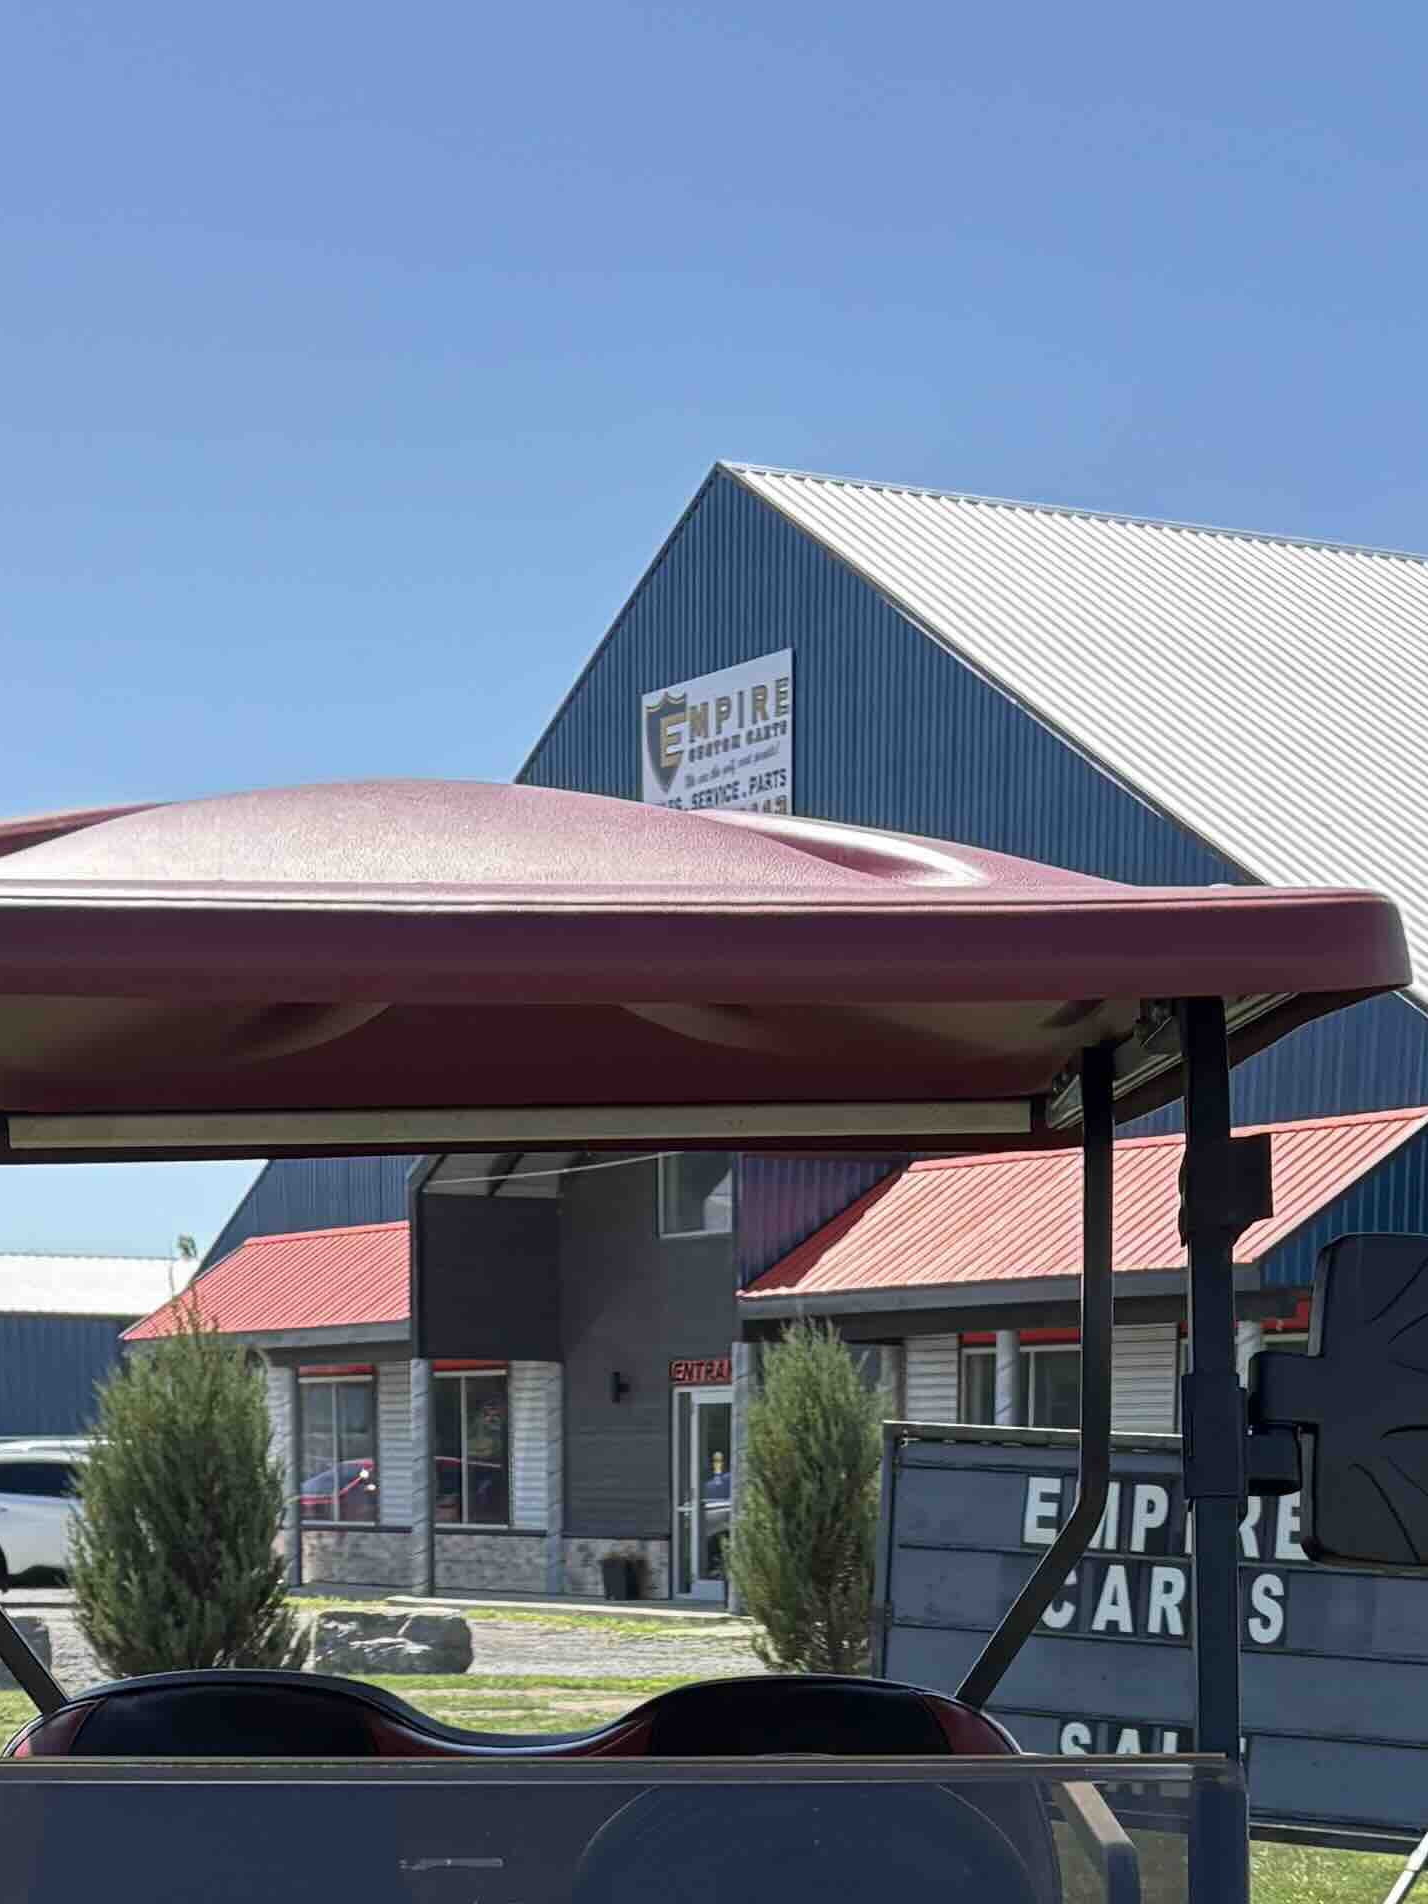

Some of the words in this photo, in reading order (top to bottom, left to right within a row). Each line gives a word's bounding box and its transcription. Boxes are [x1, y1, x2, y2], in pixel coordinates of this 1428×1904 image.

[660, 676, 789, 768] EMPIRE
[691, 780, 740, 808] SERVICE
[749, 768, 787, 795] PARTS
[674, 1360, 732, 1383] ENTRA
[1041, 1564, 1285, 1644] CARS
